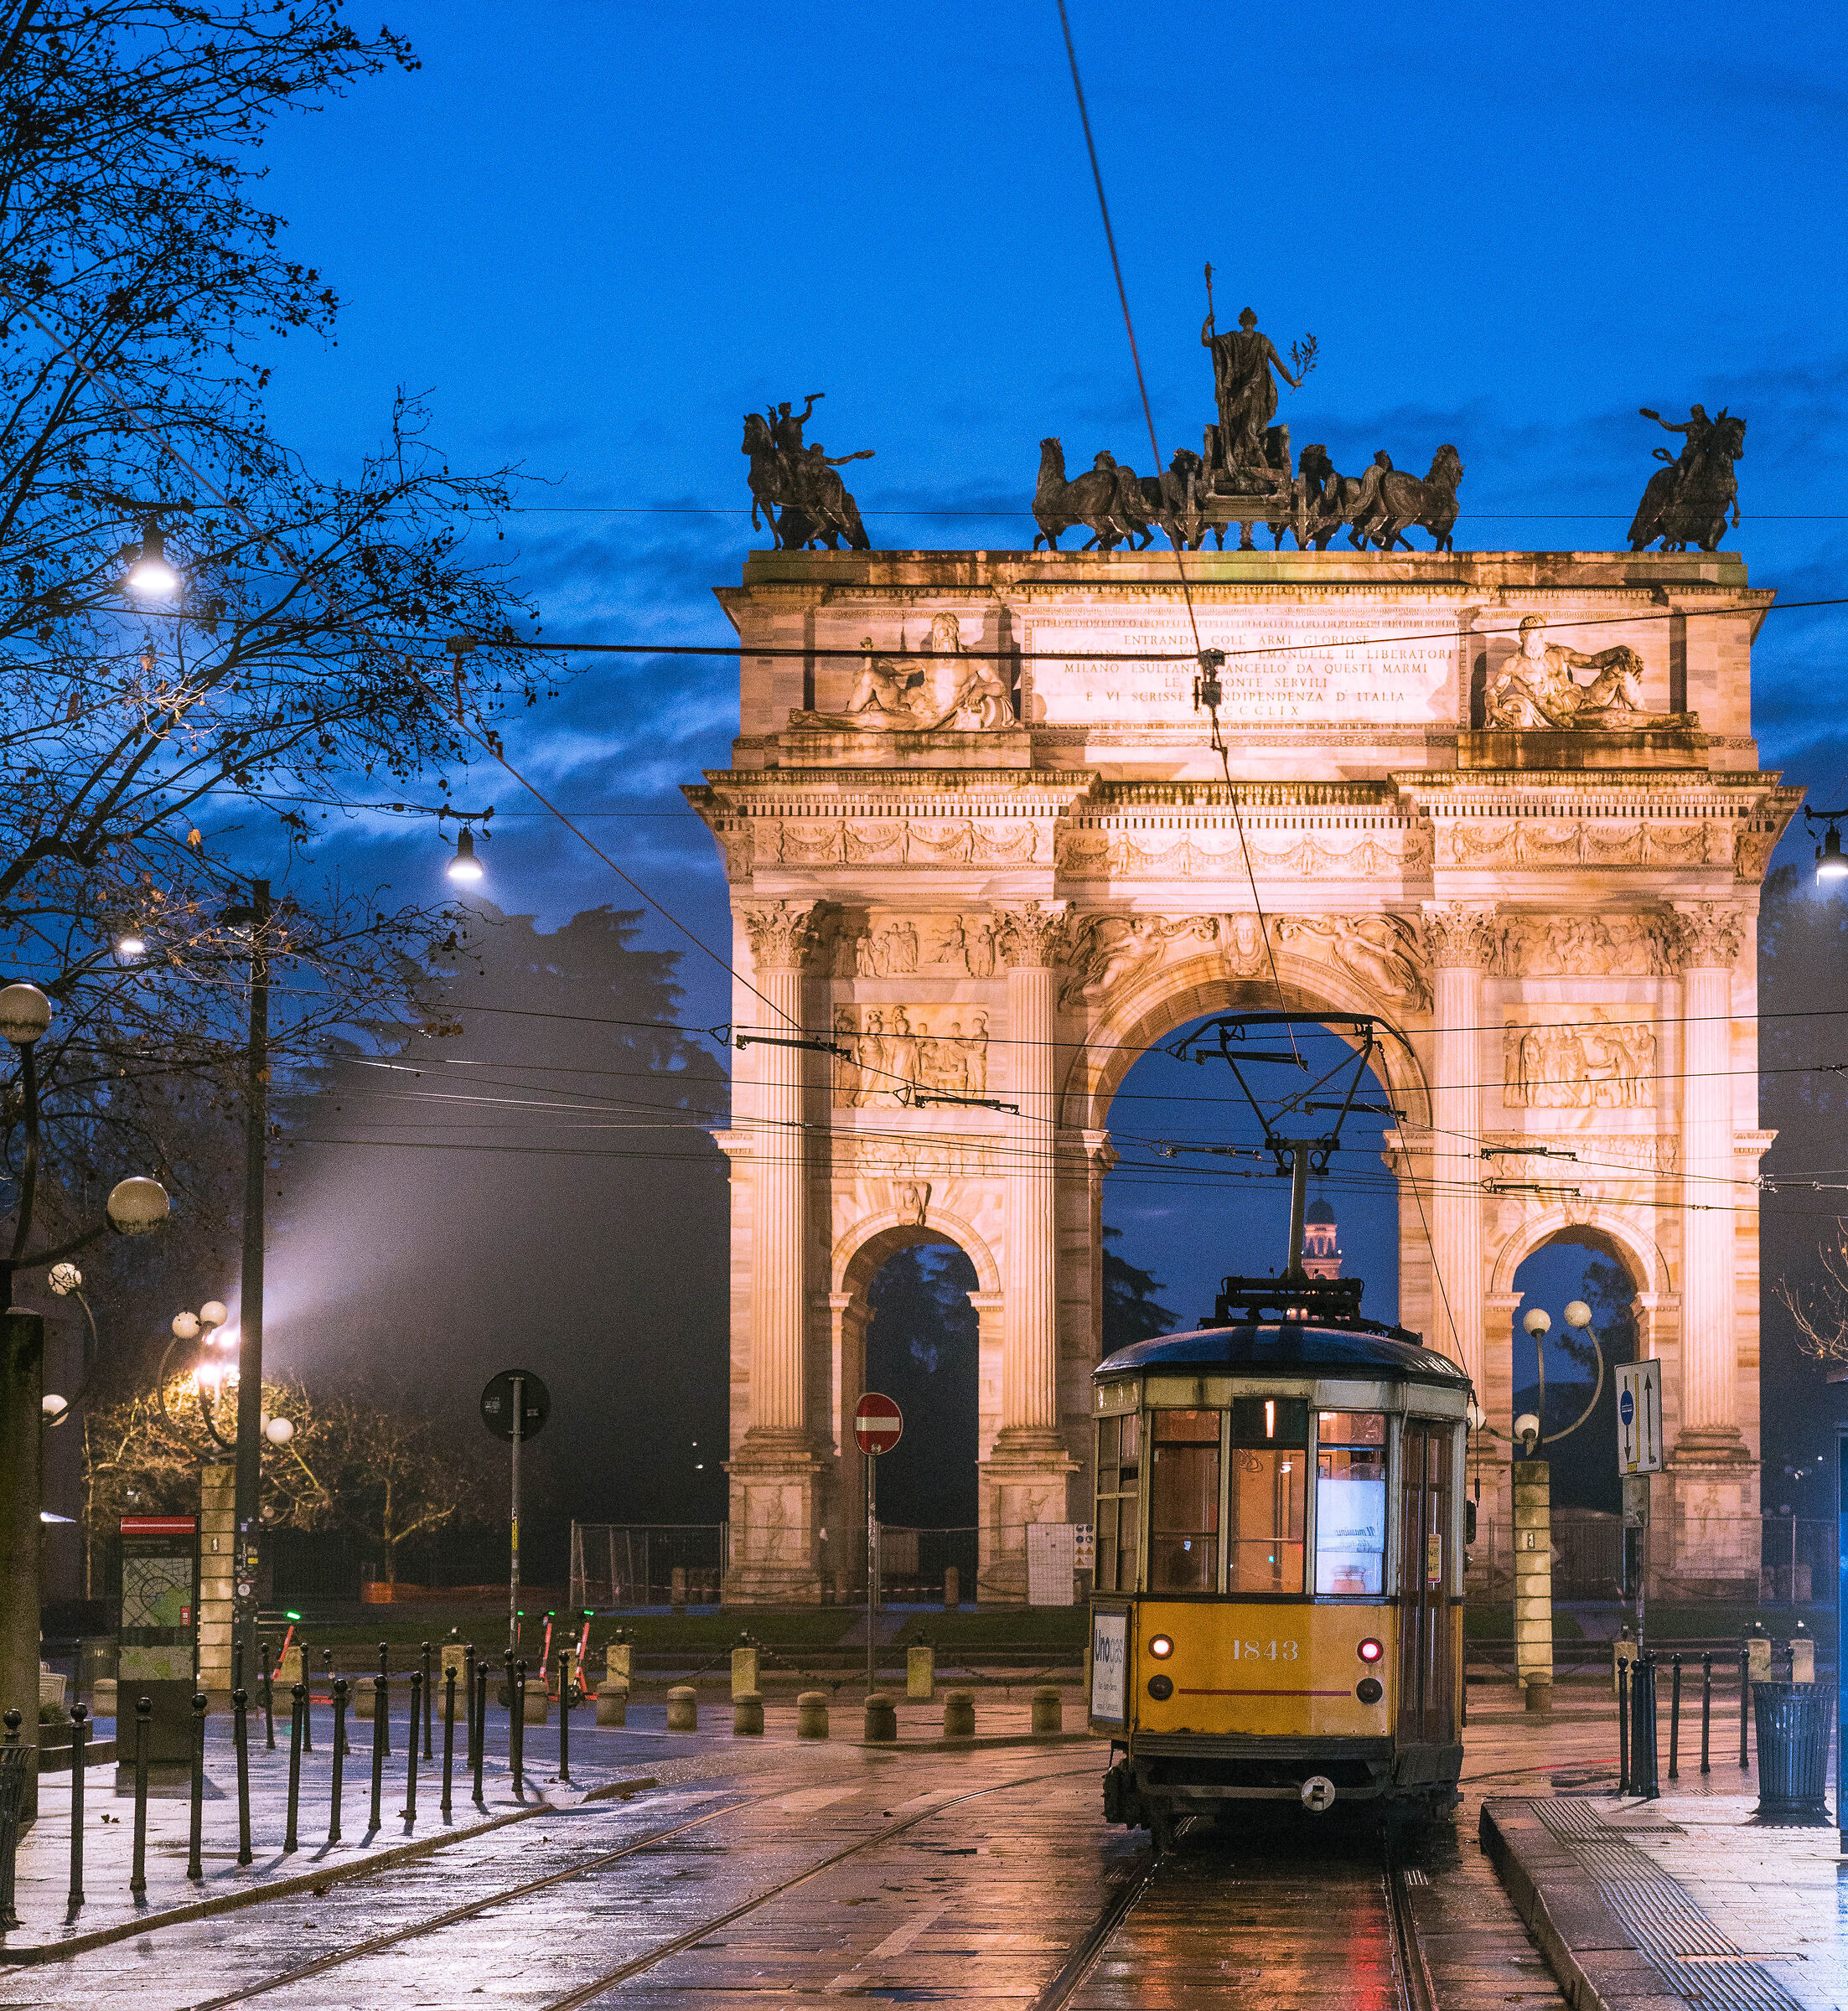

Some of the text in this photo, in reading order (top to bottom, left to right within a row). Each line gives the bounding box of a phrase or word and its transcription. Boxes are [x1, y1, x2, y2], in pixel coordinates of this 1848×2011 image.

[1124, 635, 1198, 644] ENTRANDO
[1259, 635, 1292, 644] ARMI
[1303, 635, 1369, 645] GLORIOSE
[1259, 650, 1333, 659] EMANUELE
[1345, 649, 1354, 659] II
[1367, 649, 1452, 659] LIBERATORI
[1064, 664, 1119, 674] MILANO
[1297, 664, 1313, 674] DA
[1324, 664, 1373, 675] QUESTI
[1383, 664, 1427, 674] MARMI
[1165, 679, 1180, 687] LE
[1275, 678, 1327, 688] SERVILI
[1086, 692, 1093, 701] E
[1107, 692, 1120, 701] VI
[1358, 692, 1404, 701] ITALIA
[1265, 1400, 1274, 1438] 1
[1234, 1640, 1298, 1661] 1843
